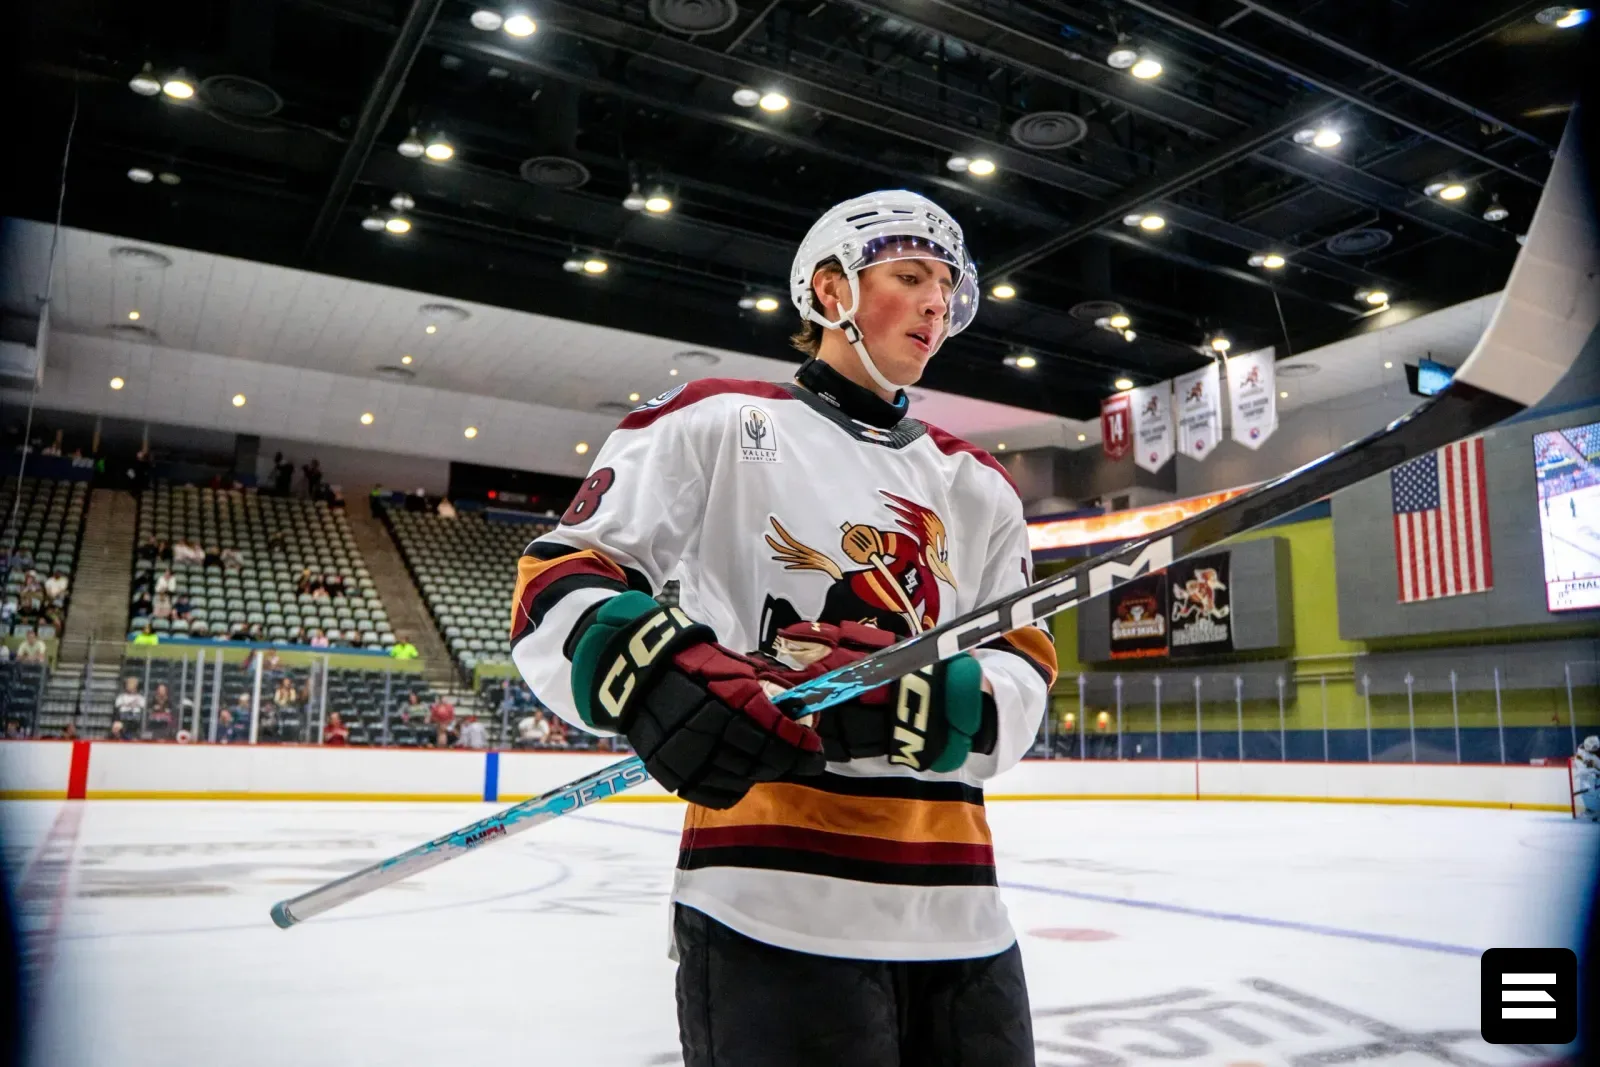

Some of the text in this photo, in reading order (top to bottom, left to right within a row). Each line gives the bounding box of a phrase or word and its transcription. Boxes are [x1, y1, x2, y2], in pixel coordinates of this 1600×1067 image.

[1108, 412, 1124, 443] 14
[936, 535, 1173, 661] CCM
[891, 664, 933, 771] CM
[560, 763, 653, 816] JETS
